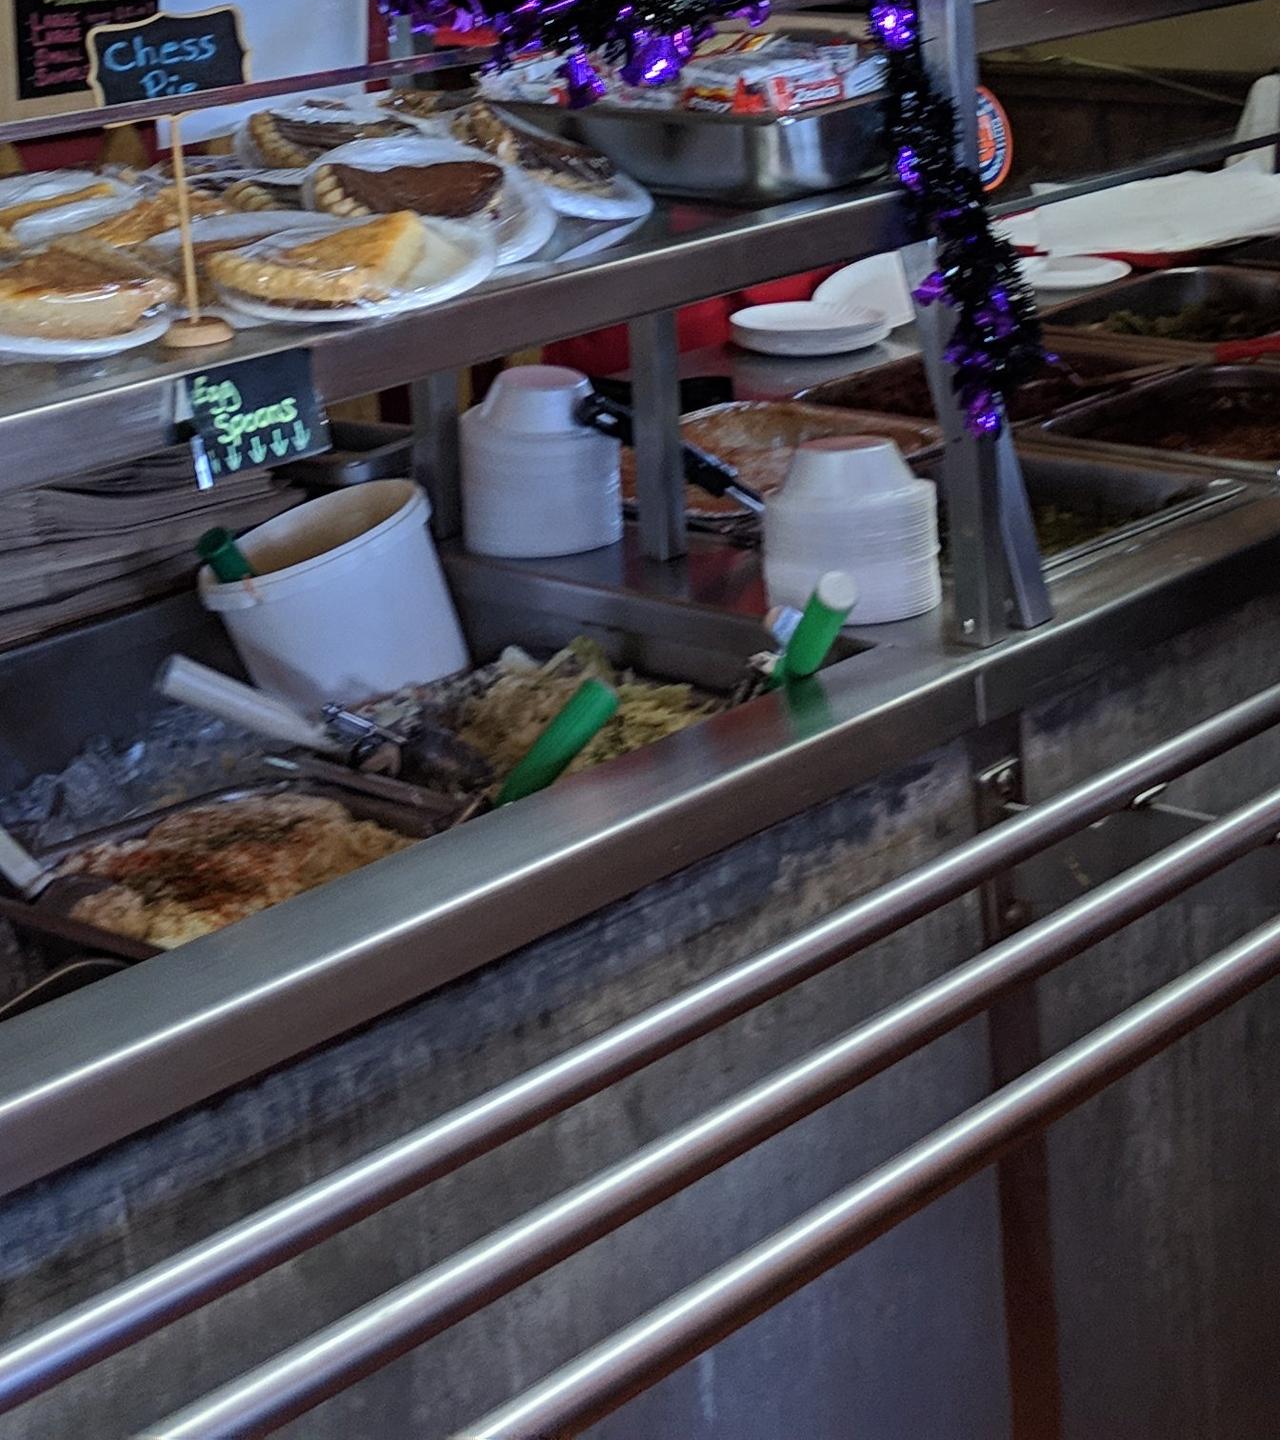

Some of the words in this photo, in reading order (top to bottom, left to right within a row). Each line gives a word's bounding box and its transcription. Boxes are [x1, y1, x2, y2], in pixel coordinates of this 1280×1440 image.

[103, 34, 218, 71] Chess
[139, 69, 199, 97] Pie
[193, 375, 242, 415] Egg
[213, 397, 298, 447] Spoons
